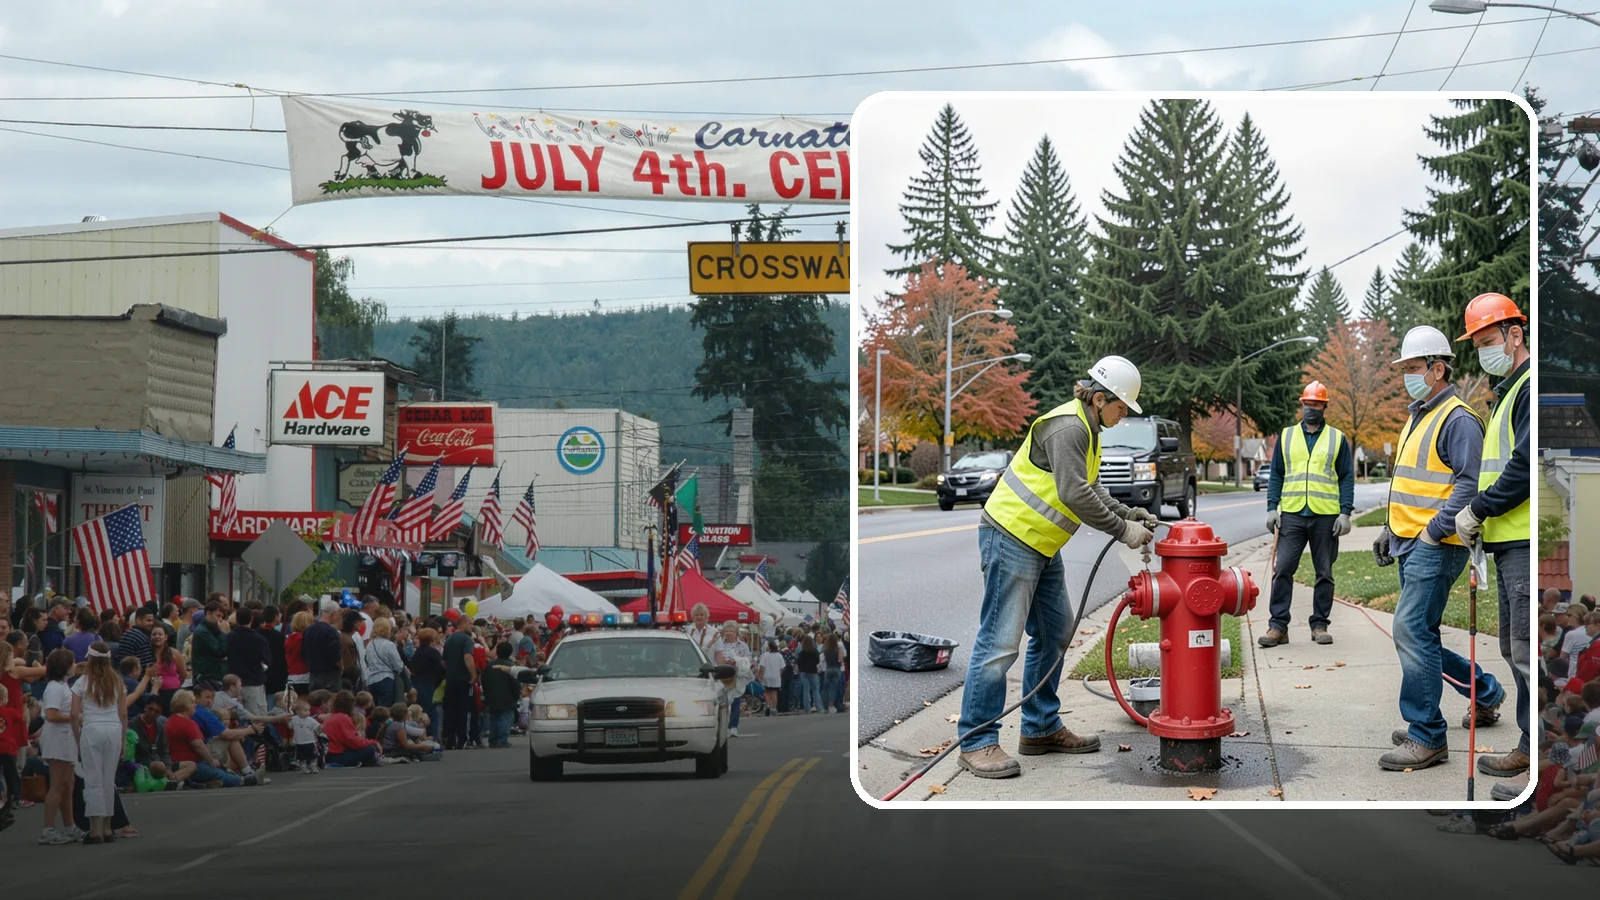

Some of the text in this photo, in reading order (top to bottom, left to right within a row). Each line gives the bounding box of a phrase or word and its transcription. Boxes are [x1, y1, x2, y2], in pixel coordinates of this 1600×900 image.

[481, 141, 604, 192] JULY
[632, 150, 746, 197] 4th.
[697, 254, 850, 280] CROSSWA
[283, 380, 373, 419] ACE
[405, 409, 452, 422] CEDAR
[284, 421, 370, 436] Hardware
[353, 467, 386, 481] Simpl
[95, 485, 124, 495] Vincent
[126, 486, 136, 495] de
[138, 486, 155, 495] Paul
[212, 516, 330, 535] HARDARE
[688, 526, 742, 535] CRNATION
[699, 535, 730, 543] GLASS
